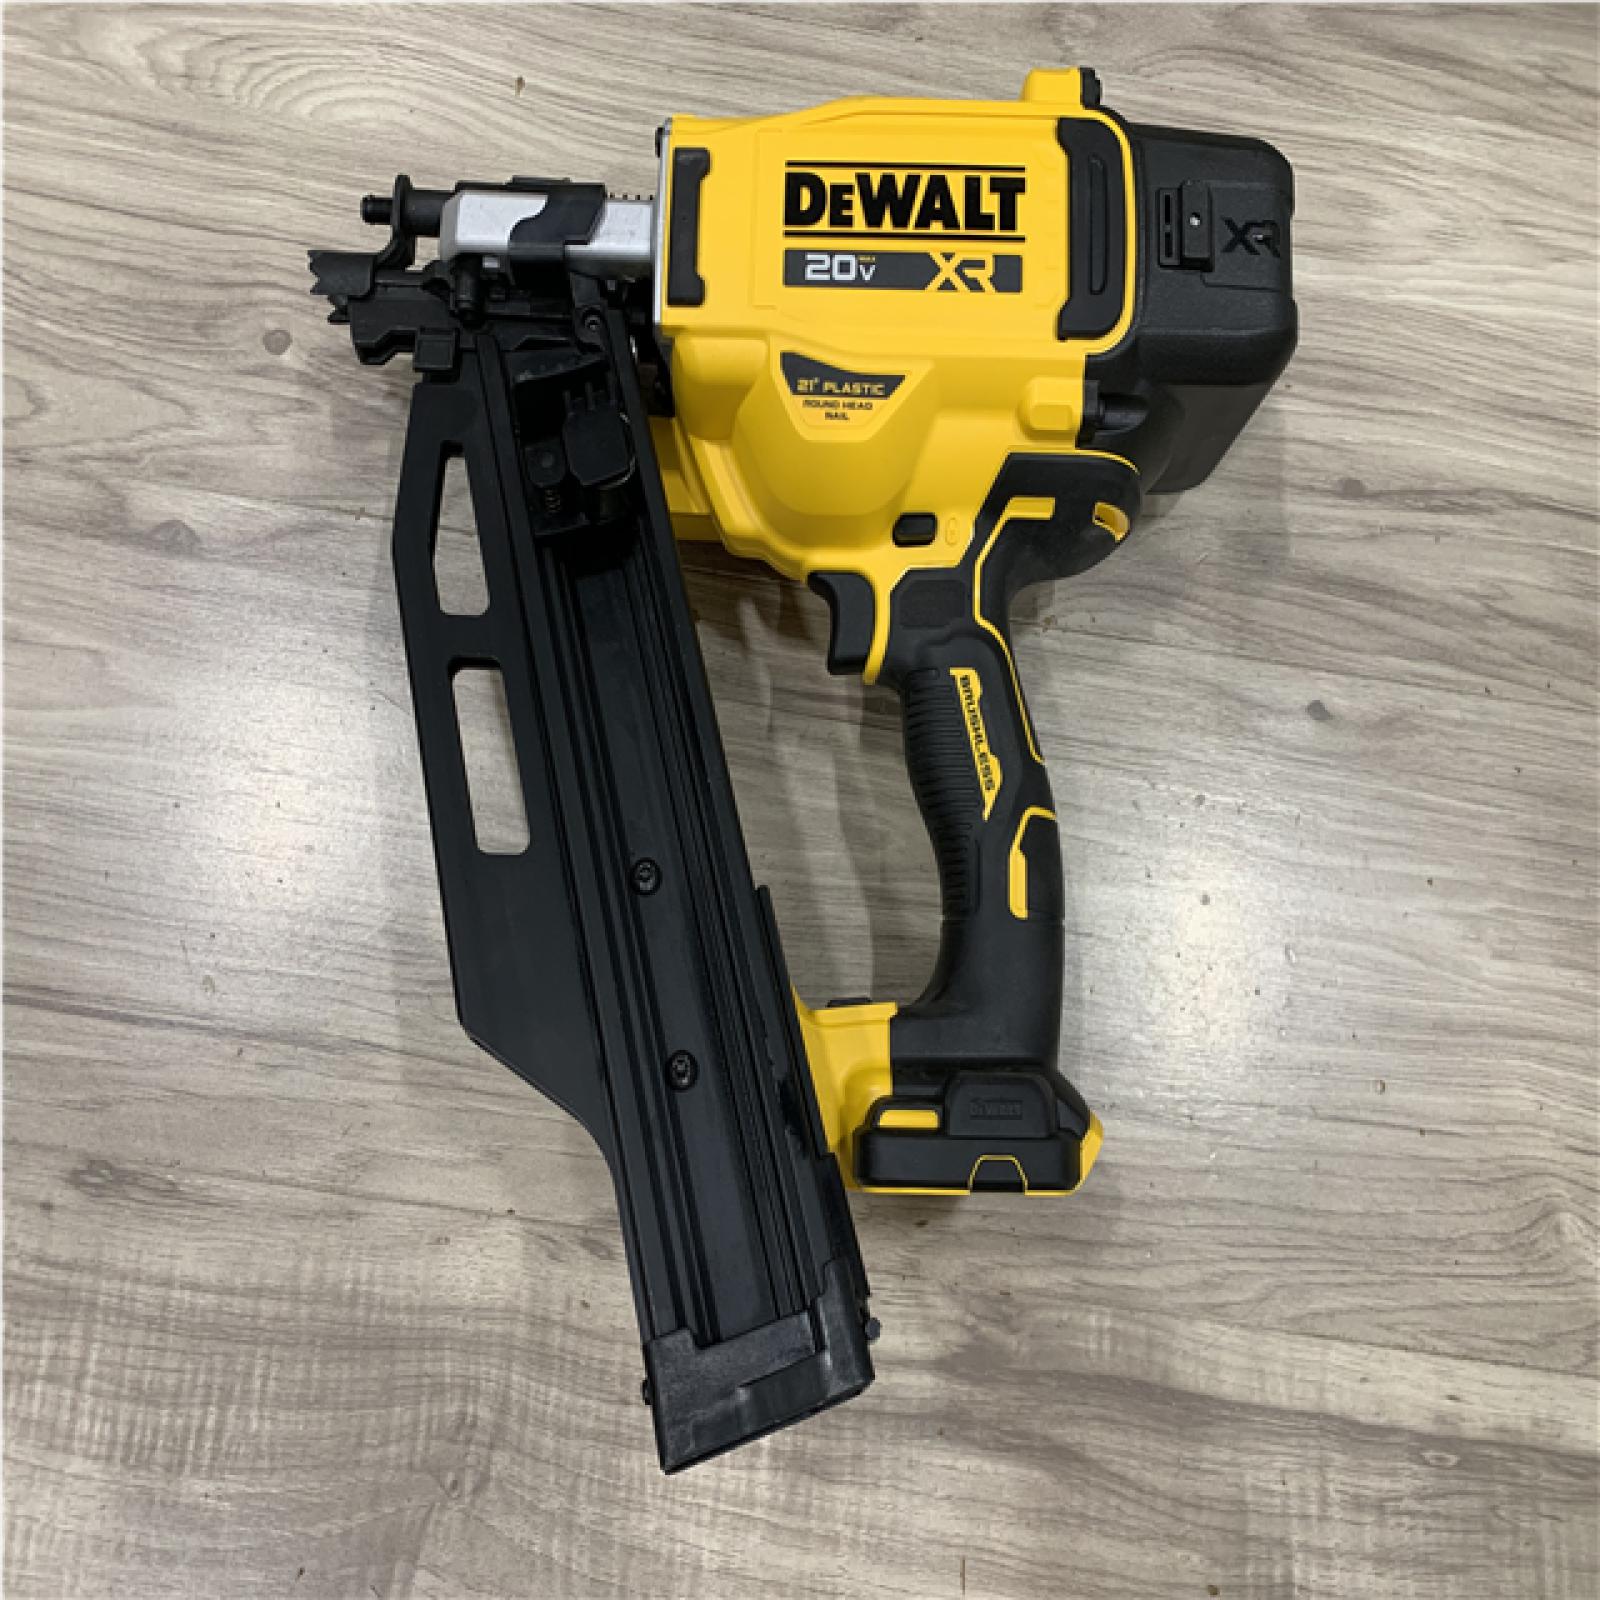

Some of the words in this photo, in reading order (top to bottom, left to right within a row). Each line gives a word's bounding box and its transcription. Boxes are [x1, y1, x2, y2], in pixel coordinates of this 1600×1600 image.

[1221, 217, 1281, 258] XR
[924, 252, 997, 292] XR
[822, 381, 885, 396] PLASTIC
[842, 401, 873, 410] HEAD
[824, 411, 849, 420] NAIL
